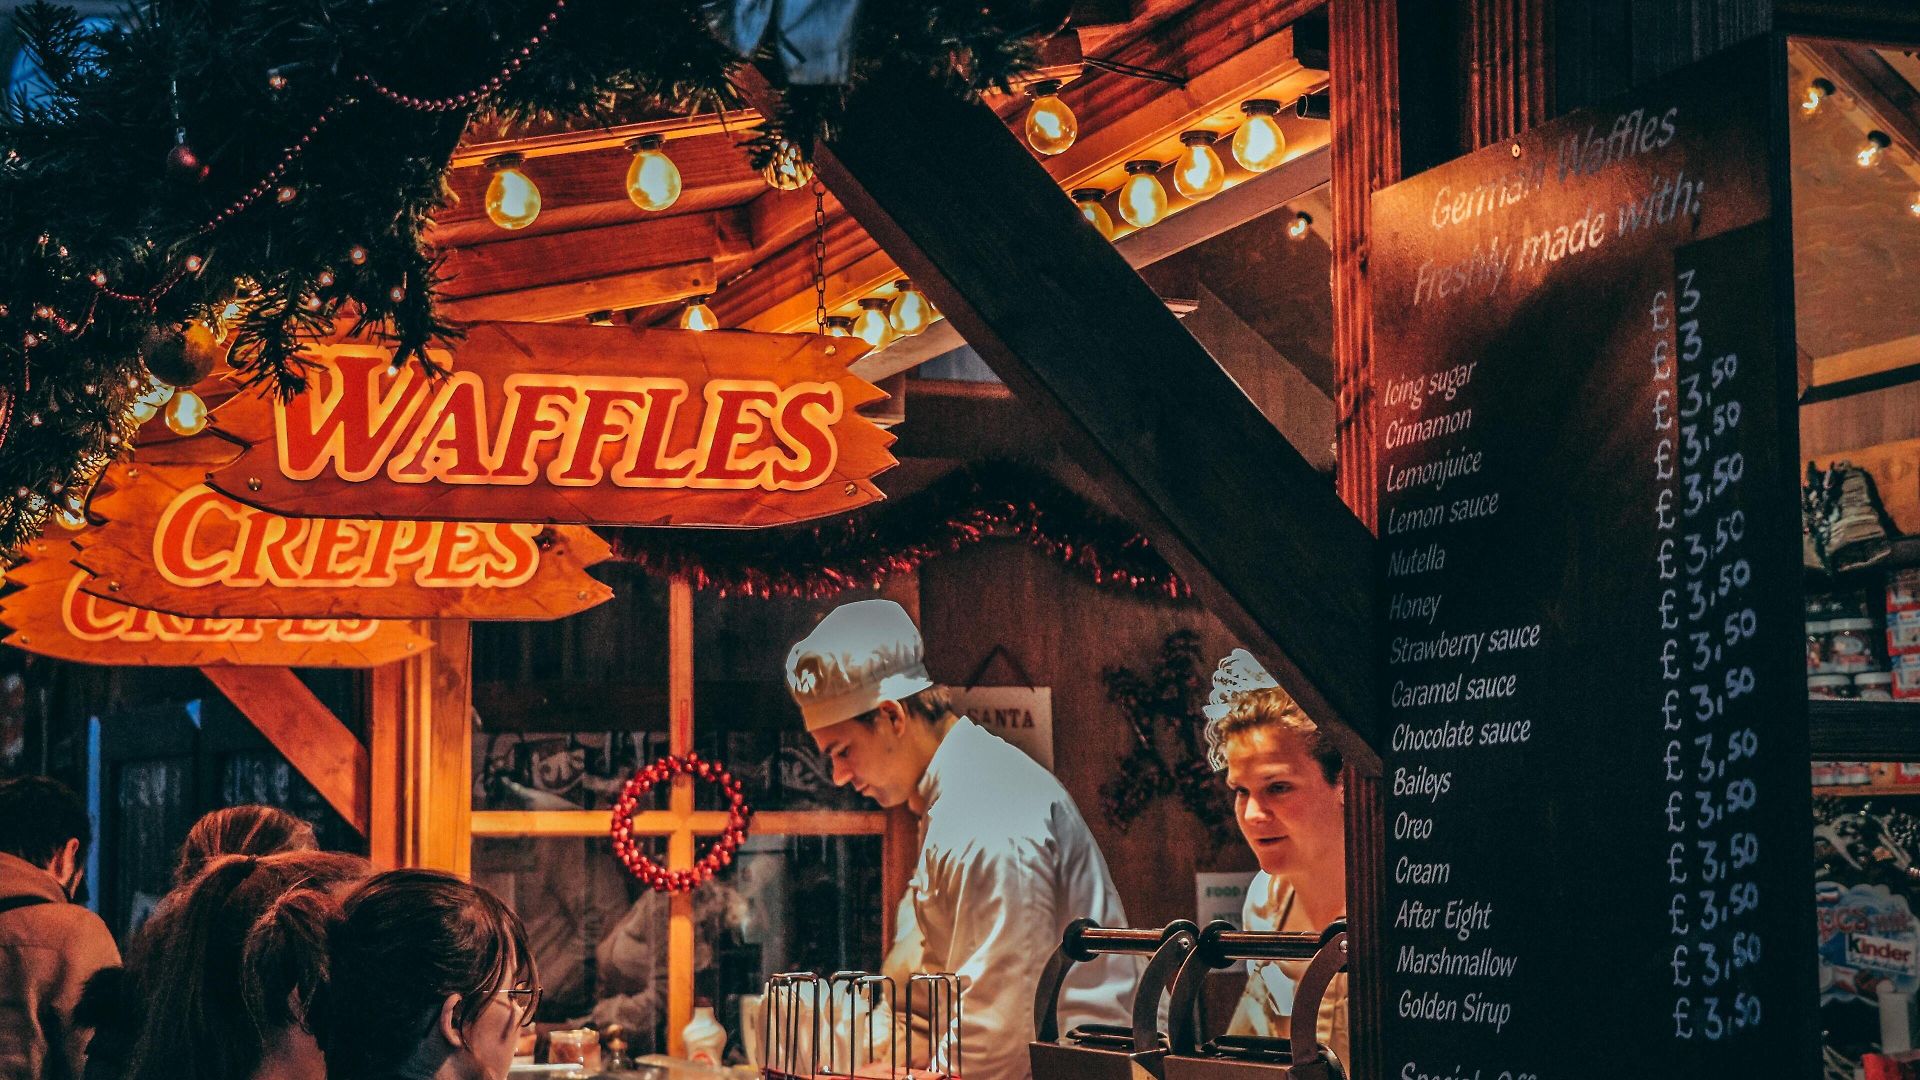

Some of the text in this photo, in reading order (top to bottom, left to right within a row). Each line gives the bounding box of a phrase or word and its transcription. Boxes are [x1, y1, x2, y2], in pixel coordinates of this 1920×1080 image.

[1431, 106, 1678, 231] German Waffles
[1518, 206, 1605, 272] made
[1617, 171, 1704, 237] with:
[1384, 361, 1477, 410] Icing sugar
[278, 343, 842, 490] WAFFLES
[1385, 408, 1472, 449] Cinnamon
[1387, 446, 1482, 492] Lemonjuice
[1388, 492, 1499, 535] Lemon sauce
[154, 484, 543, 588] CREPES
[1388, 544, 1445, 577] Nutella
[1389, 593, 1442, 625] Honey
[1390, 624, 1540, 664] Strawberry sauce
[1391, 673, 1517, 708] Caramel sauce
[966, 708, 1034, 729] SANTA
[1392, 719, 1531, 751] Chocolate sauce
[1393, 765, 1451, 803] Baileys
[1394, 811, 1432, 840] Oreo
[1395, 856, 1450, 884] Cream
[1394, 899, 1492, 941] After Eight
[1396, 945, 1517, 977] Marshmallow
[1399, 989, 1511, 1034] Golden Sirup
